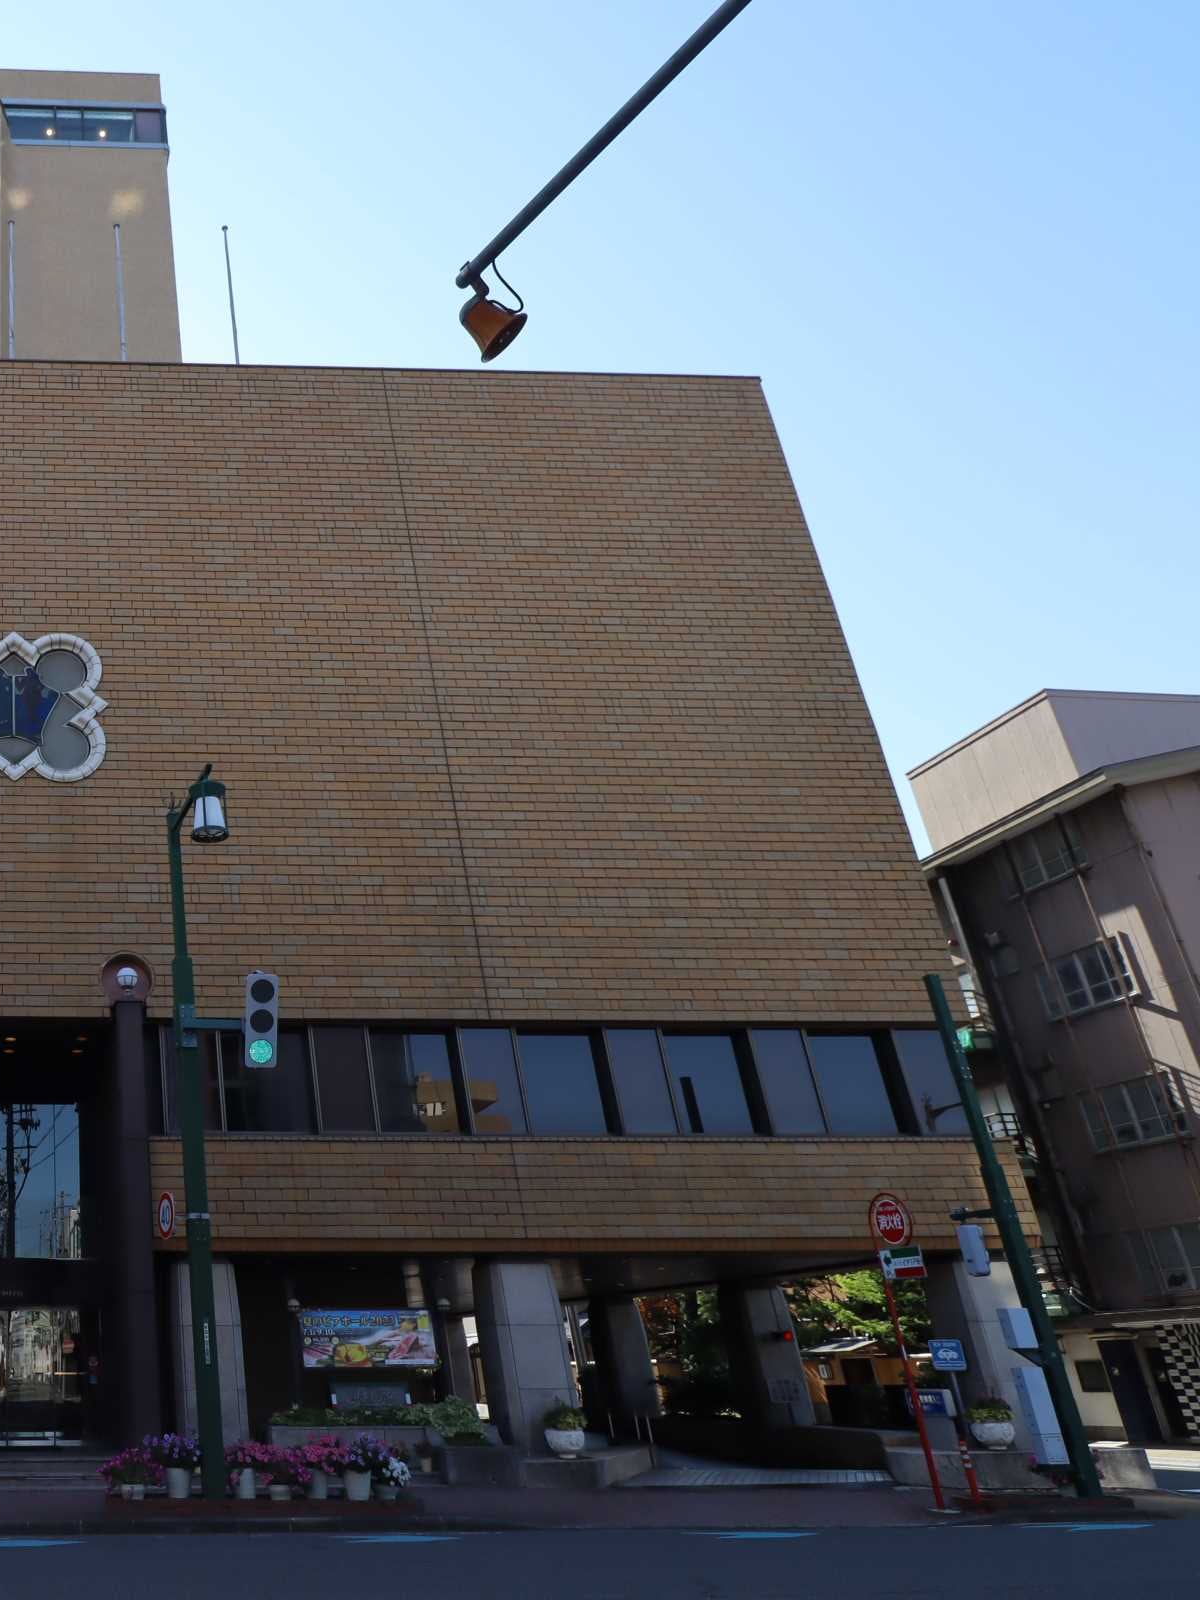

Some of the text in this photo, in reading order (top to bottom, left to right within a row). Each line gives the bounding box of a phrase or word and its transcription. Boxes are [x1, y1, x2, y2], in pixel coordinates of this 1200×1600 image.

[161, 1205, 171, 1227] 40
[877, 1214, 904, 1231] 消火栓
